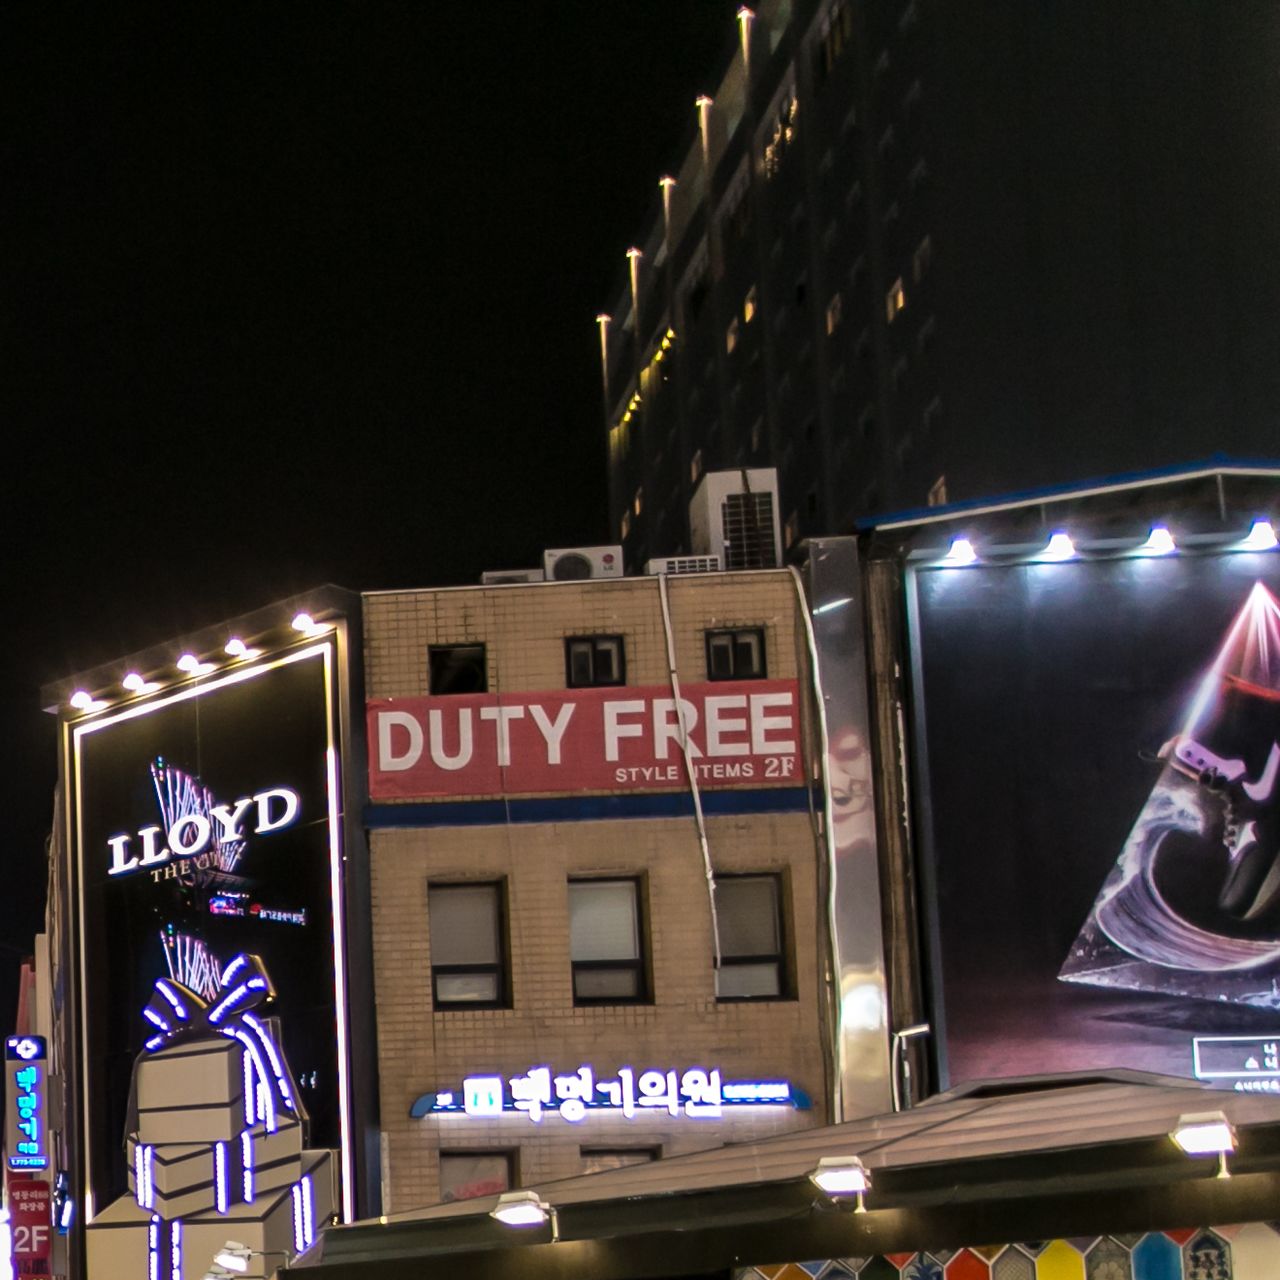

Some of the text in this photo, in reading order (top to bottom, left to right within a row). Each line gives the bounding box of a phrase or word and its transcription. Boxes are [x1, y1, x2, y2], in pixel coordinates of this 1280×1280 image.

[378, 692, 796, 772] DUTY FREE
[616, 766, 679, 783] STYLE
[765, 757, 796, 778] 2F
[108, 789, 298, 875] LLOYD
[151, 859, 192, 883] THE
[14, 1226, 48, 1252] 2F
